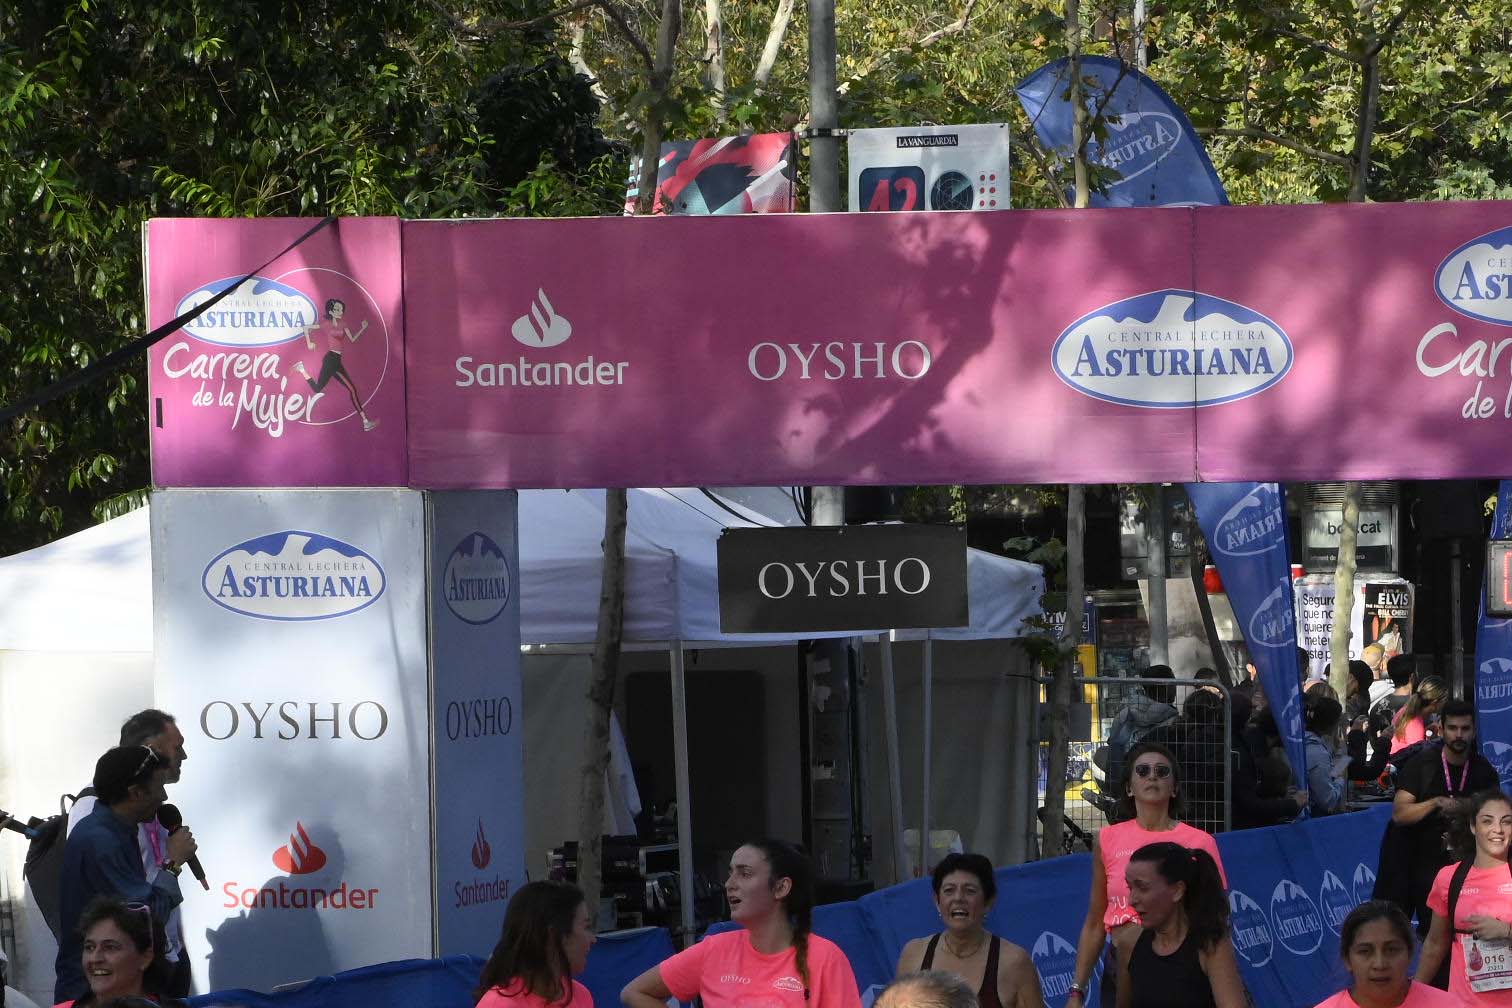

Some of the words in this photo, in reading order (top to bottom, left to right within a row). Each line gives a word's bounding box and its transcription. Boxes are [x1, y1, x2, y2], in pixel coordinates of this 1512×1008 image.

[1107, 329, 1182, 342] CENTRAL
[1192, 328, 1267, 341] LECHERA
[163, 343, 281, 380] Carrera
[455, 354, 630, 387] Santander
[747, 340, 933, 381] OYSHO
[1071, 334, 1275, 377] ASTURIANA
[192, 381, 214, 407] de
[219, 381, 235, 407] la
[233, 376, 326, 438] Mujer
[1461, 379, 1495, 419] de
[1328, 520, 1381, 535] b.cat
[217, 565, 372, 598] ASTURIANA
[244, 562, 303, 571] CENTRAL
[308, 561, 366, 571] LECHERA
[758, 557, 930, 599] OYSHO
[449, 568, 506, 602] ASTURIANA
[1378, 592, 1409, 605] ELVIS
[1304, 608, 1319, 620] que
[1304, 622, 1332, 635] quiere
[199, 701, 389, 741] OYSHO
[445, 696, 512, 741] OYSHO
[223, 882, 380, 911] Santander
[455, 877, 509, 910] Santander
[1484, 955, 1505, 964] 016
